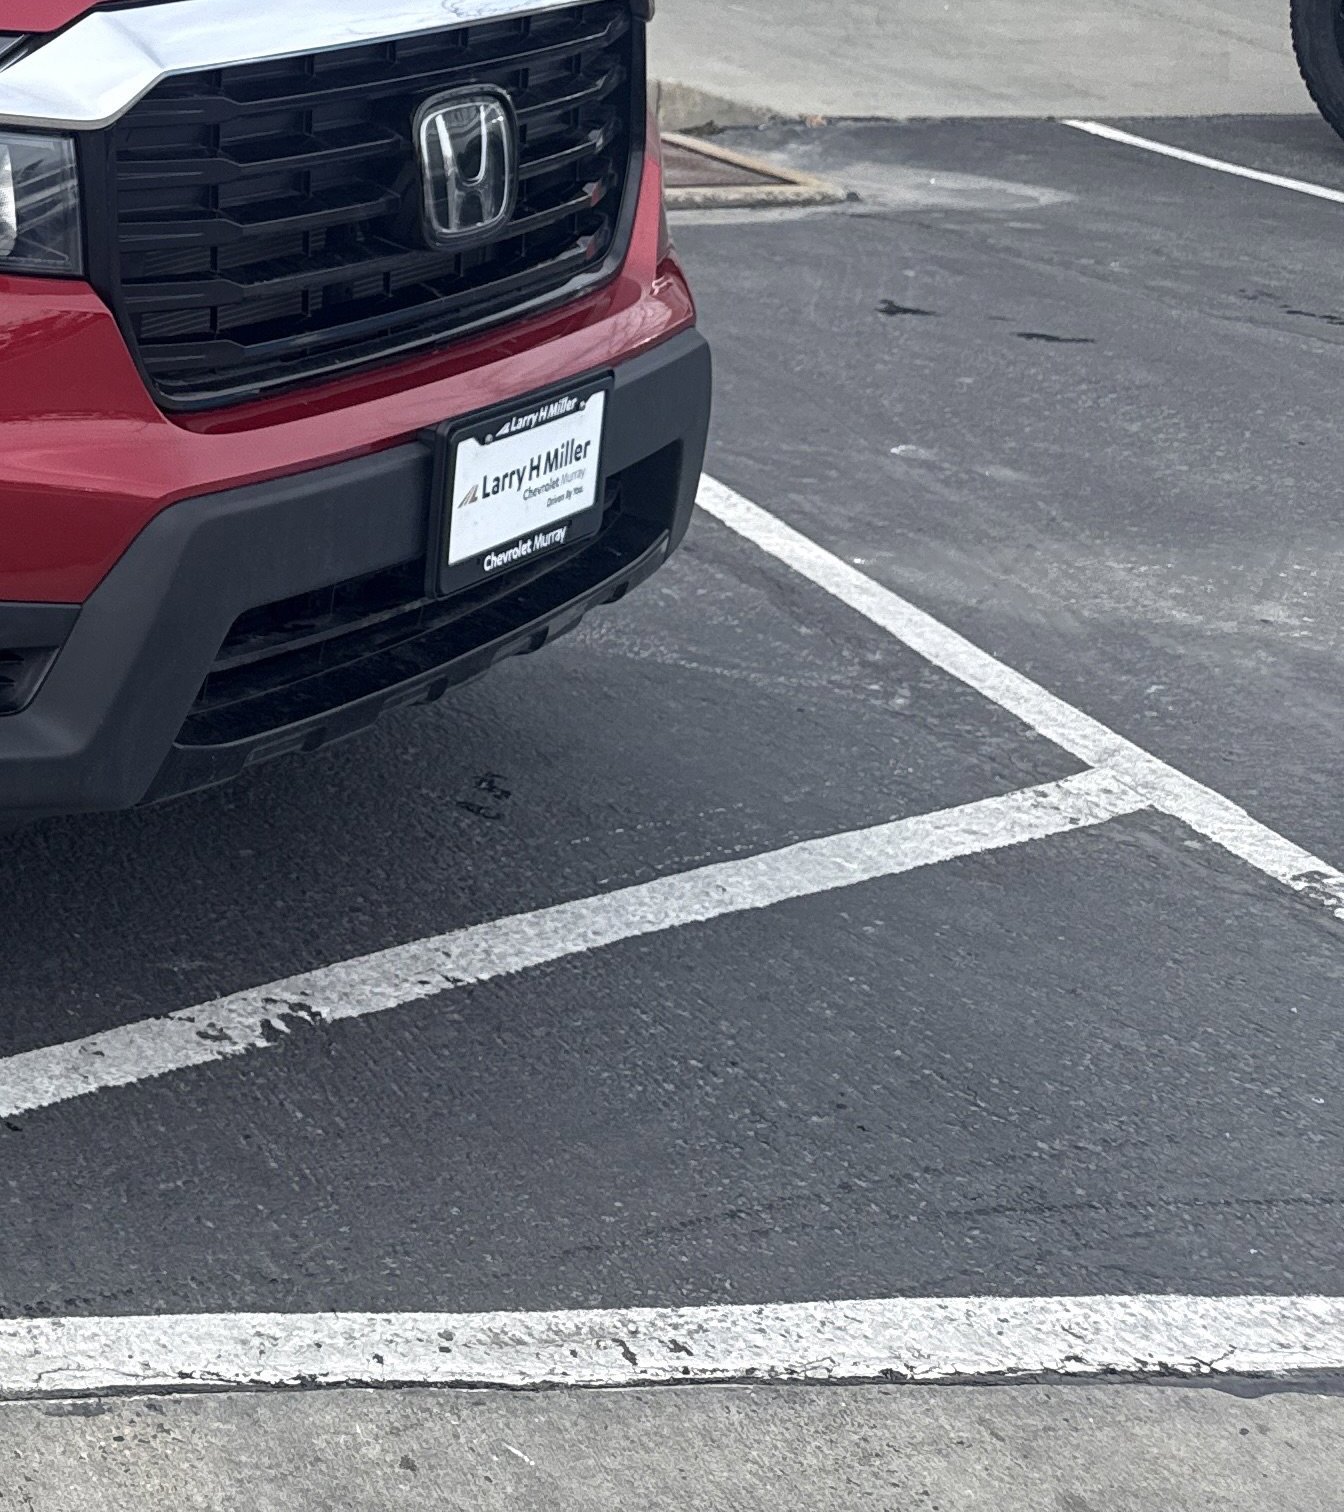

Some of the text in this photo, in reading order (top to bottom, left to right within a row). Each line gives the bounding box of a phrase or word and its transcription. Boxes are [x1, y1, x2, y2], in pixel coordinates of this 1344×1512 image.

[511, 396, 578, 432] Larry H Miller
[482, 438, 591, 499] Larry H Miller
[523, 467, 586, 501] Chevrolet Murray
[483, 526, 567, 571] Chevrolet Murray
